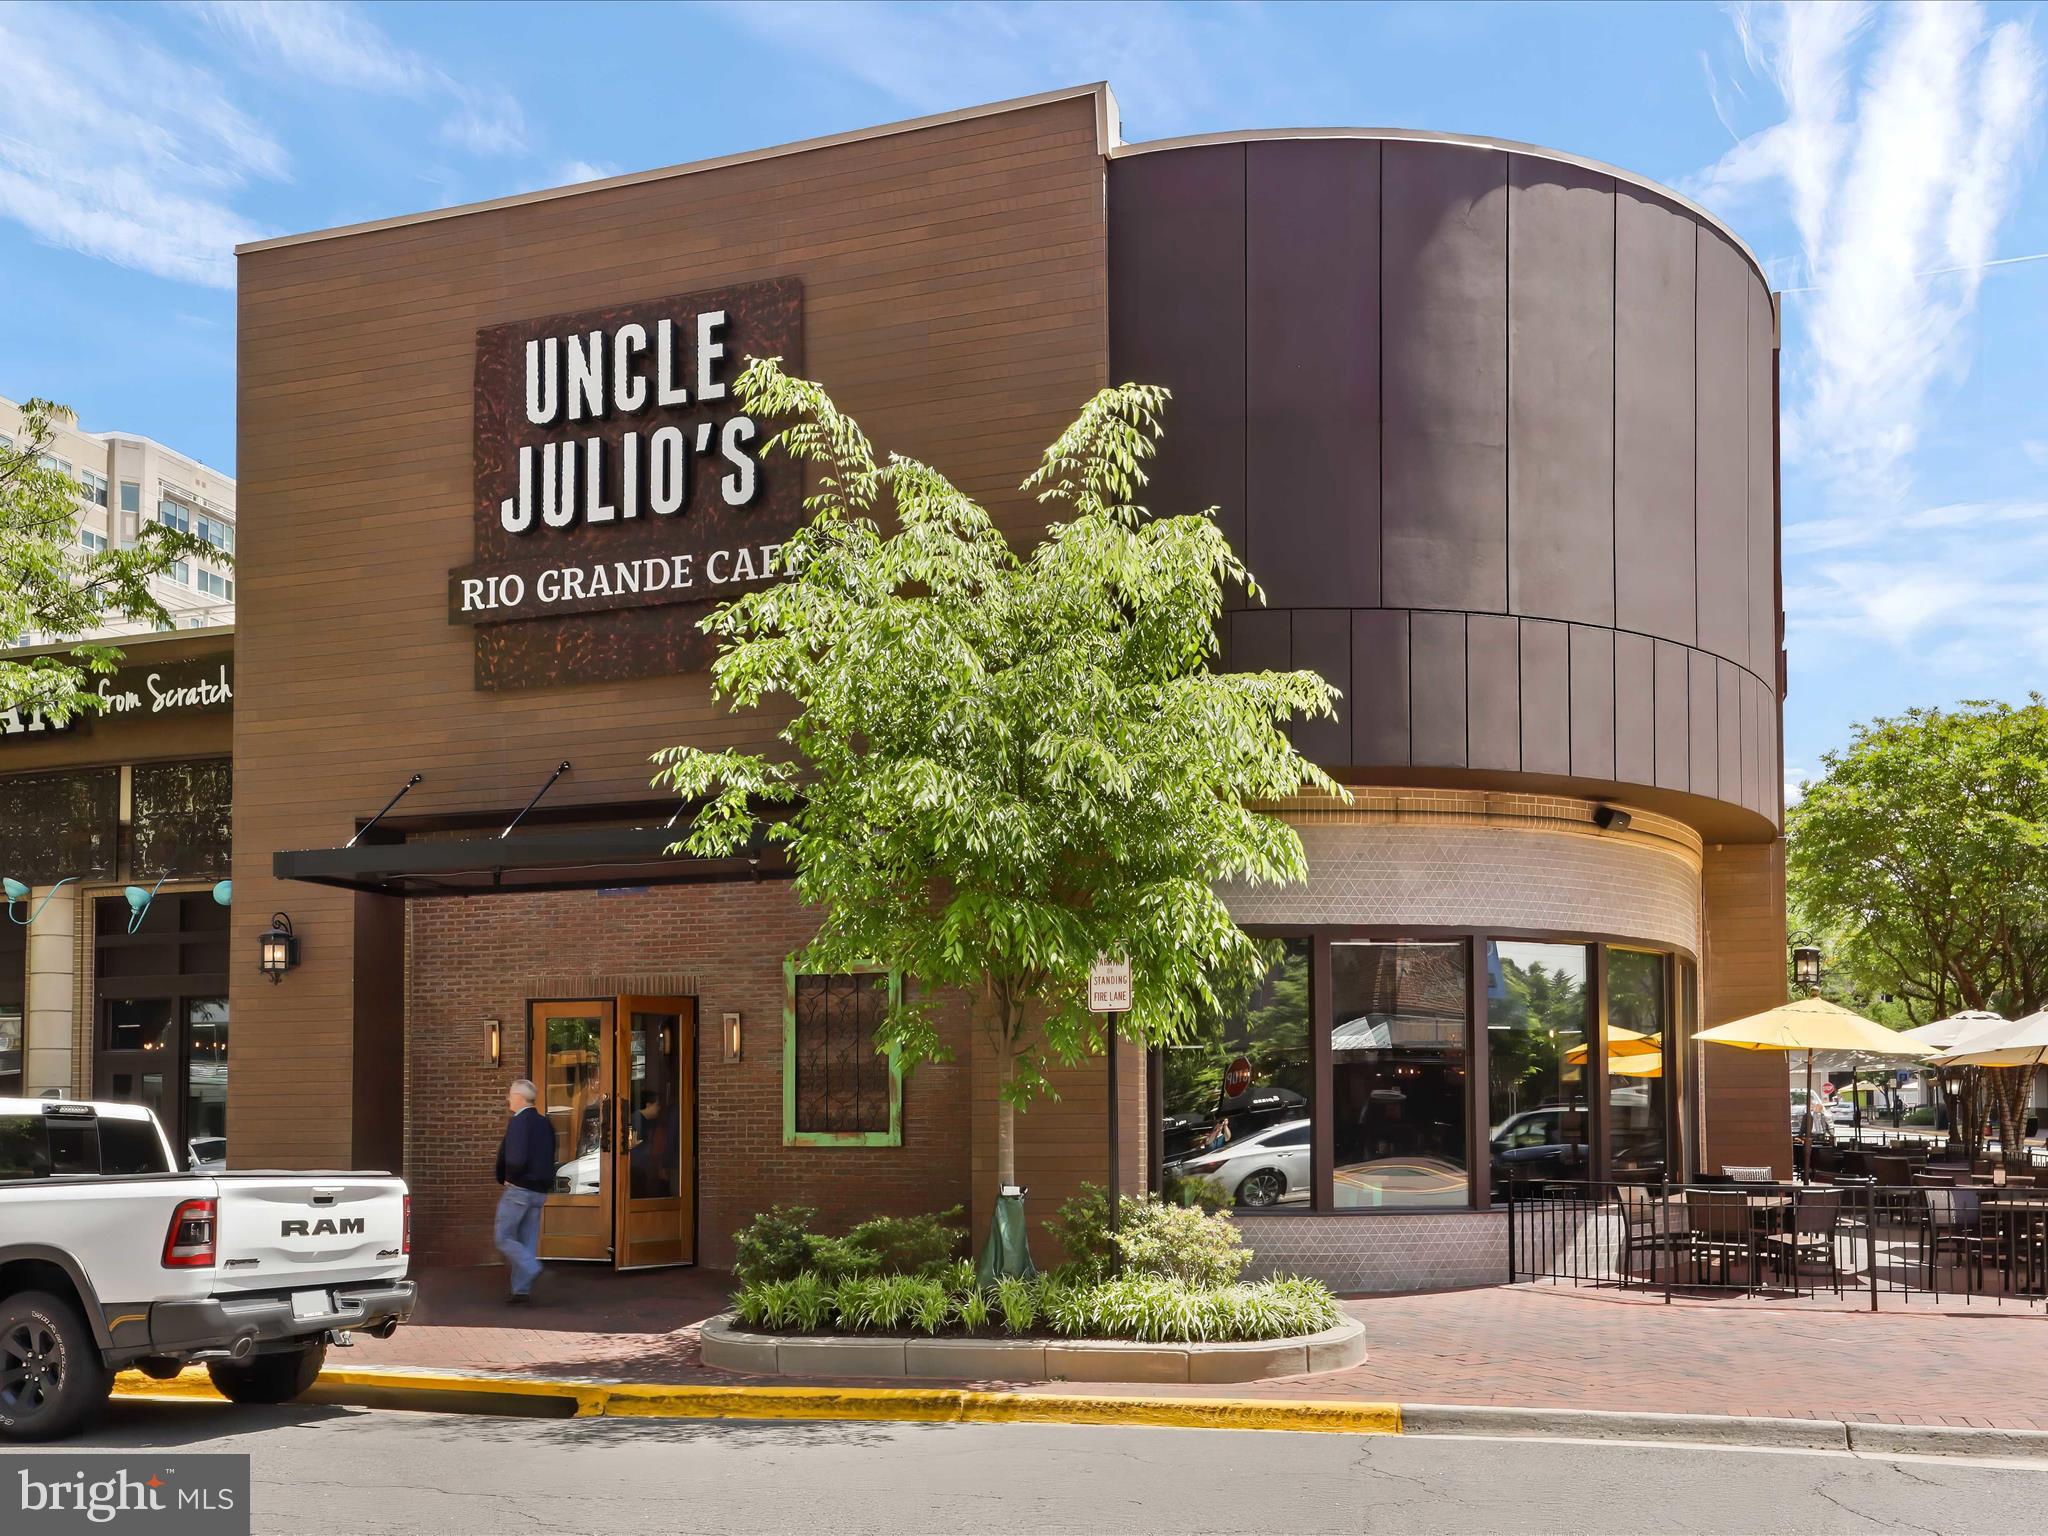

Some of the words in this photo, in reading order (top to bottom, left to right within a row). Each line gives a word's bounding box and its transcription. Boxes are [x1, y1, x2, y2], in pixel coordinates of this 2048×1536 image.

[526, 309, 726, 424] UNCLE
[501, 416, 756, 533] JULIO'S
[460, 574, 524, 612] RIO
[536, 554, 694, 603] GRANDE
[98, 678, 142, 717] from
[147, 665, 233, 713] Scratch
[1093, 976, 1128, 985] STANDING
[1094, 992, 1107, 1001] FIRE
[1110, 991, 1126, 1001] LANE
[281, 1218, 365, 1237] RAM
